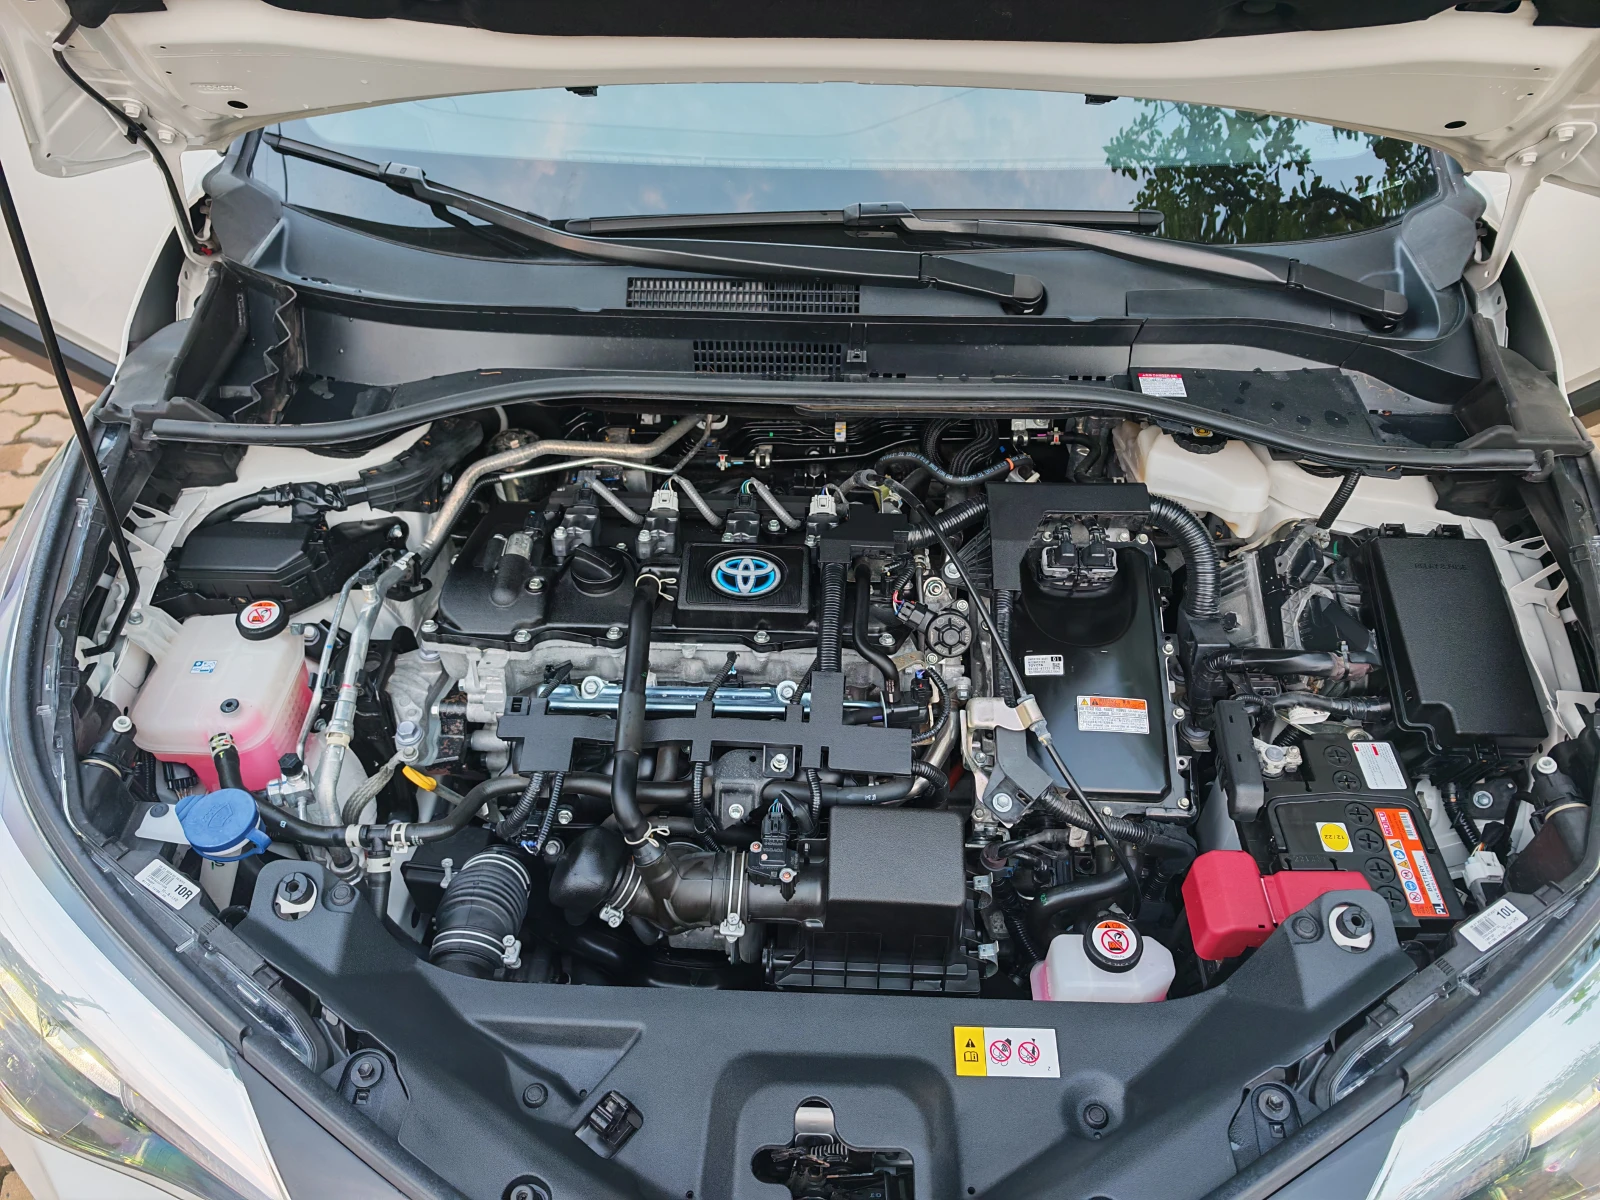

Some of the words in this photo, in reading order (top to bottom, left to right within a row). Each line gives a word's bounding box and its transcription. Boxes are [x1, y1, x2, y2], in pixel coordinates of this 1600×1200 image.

[1378, 811, 1392, 836] MUTLU
[1418, 864, 1433, 893] BATTERY
[174, 884, 193, 900] 10R
[1434, 903, 1447, 915] PL
[1496, 905, 1517, 920] 10L
